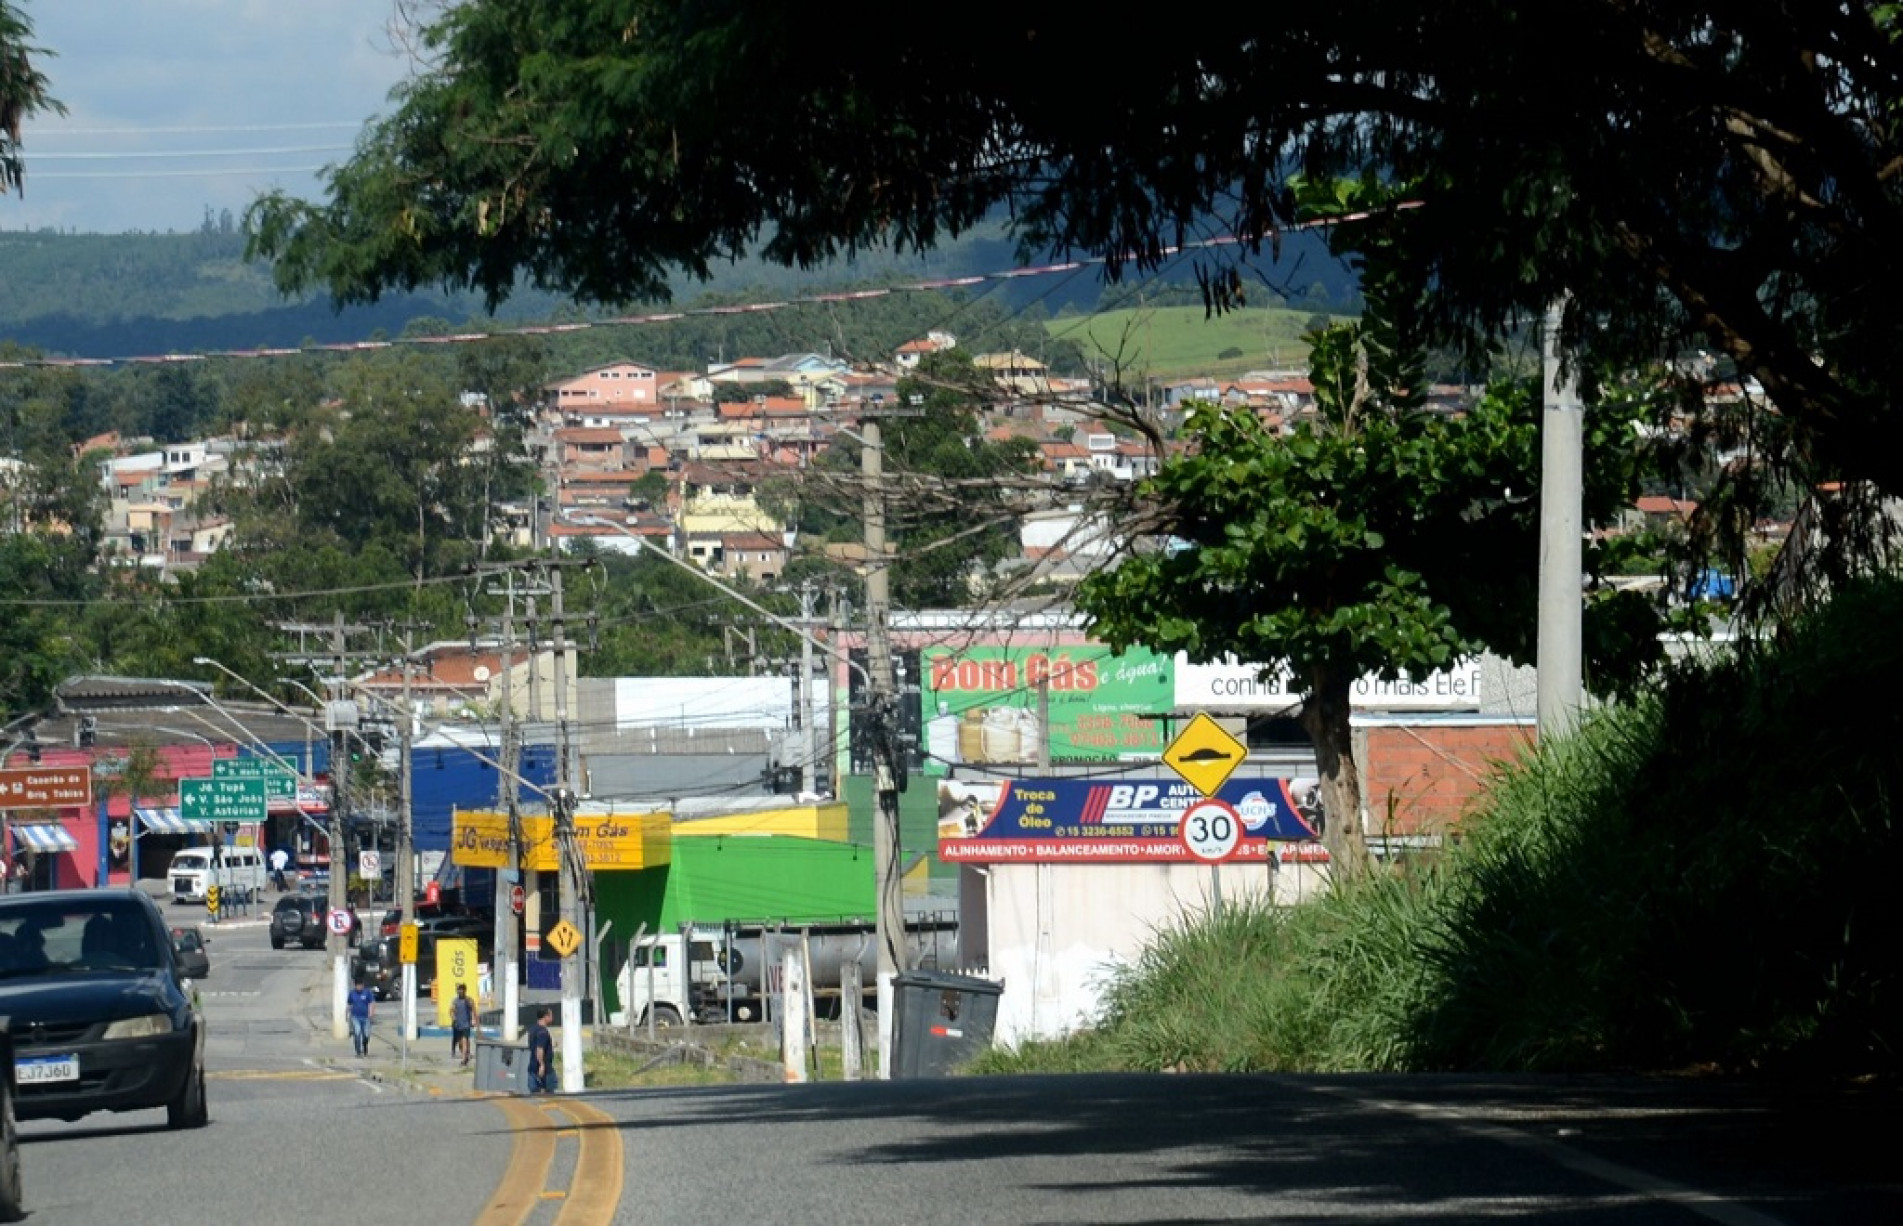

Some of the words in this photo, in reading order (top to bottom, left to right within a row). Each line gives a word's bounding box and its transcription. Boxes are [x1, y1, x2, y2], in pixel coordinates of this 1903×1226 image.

[930, 653, 1017, 691] Bom
[1025, 653, 1099, 691] Gás
[1115, 654, 1167, 686] água!
[1436, 672, 1466, 696] Ele
[198, 795, 209, 804] V.
[213, 794, 233, 804] São
[1014, 788, 1057, 801] Troca
[1109, 785, 1159, 808] BP
[198, 806, 209, 816] V.
[213, 806, 261, 816] Astúrias
[1240, 804, 1276, 816] UCHS
[597, 822, 628, 838] Gás
[1067, 825, 1080, 836] 15
[1193, 815, 1231, 842] 30
[945, 844, 1026, 857] ALINHAMENTO
[1036, 844, 1139, 857] BALANCEAMENTO
[451, 950, 465, 978] Gás
